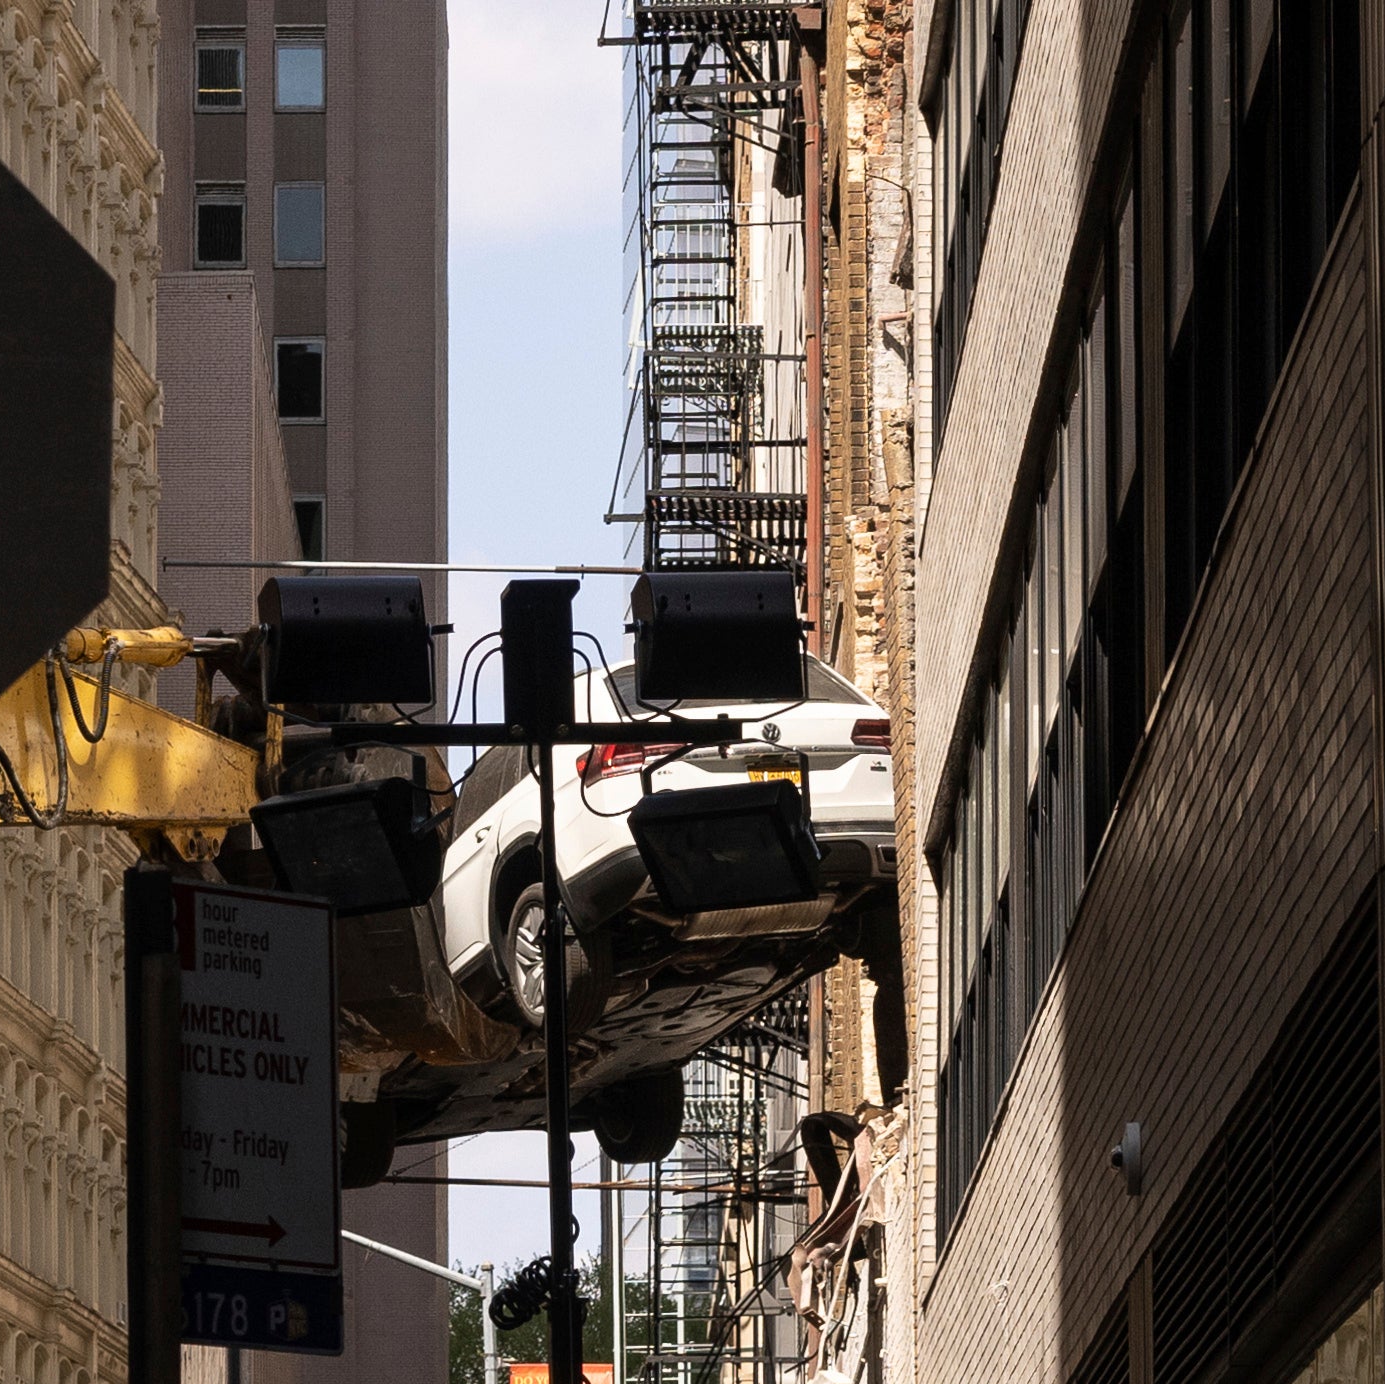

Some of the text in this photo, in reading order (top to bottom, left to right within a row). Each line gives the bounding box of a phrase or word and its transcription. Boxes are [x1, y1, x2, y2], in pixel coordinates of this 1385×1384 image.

[202, 899, 239, 923] hour
[203, 926, 270, 951] metered
[203, 950, 262, 979] parking
[179, 1043, 309, 1085] ICLES ONLY
[181, 1125, 213, 1157] day
[233, 1129, 289, 1166] Friday
[201, 1160, 241, 1192] 7pm
